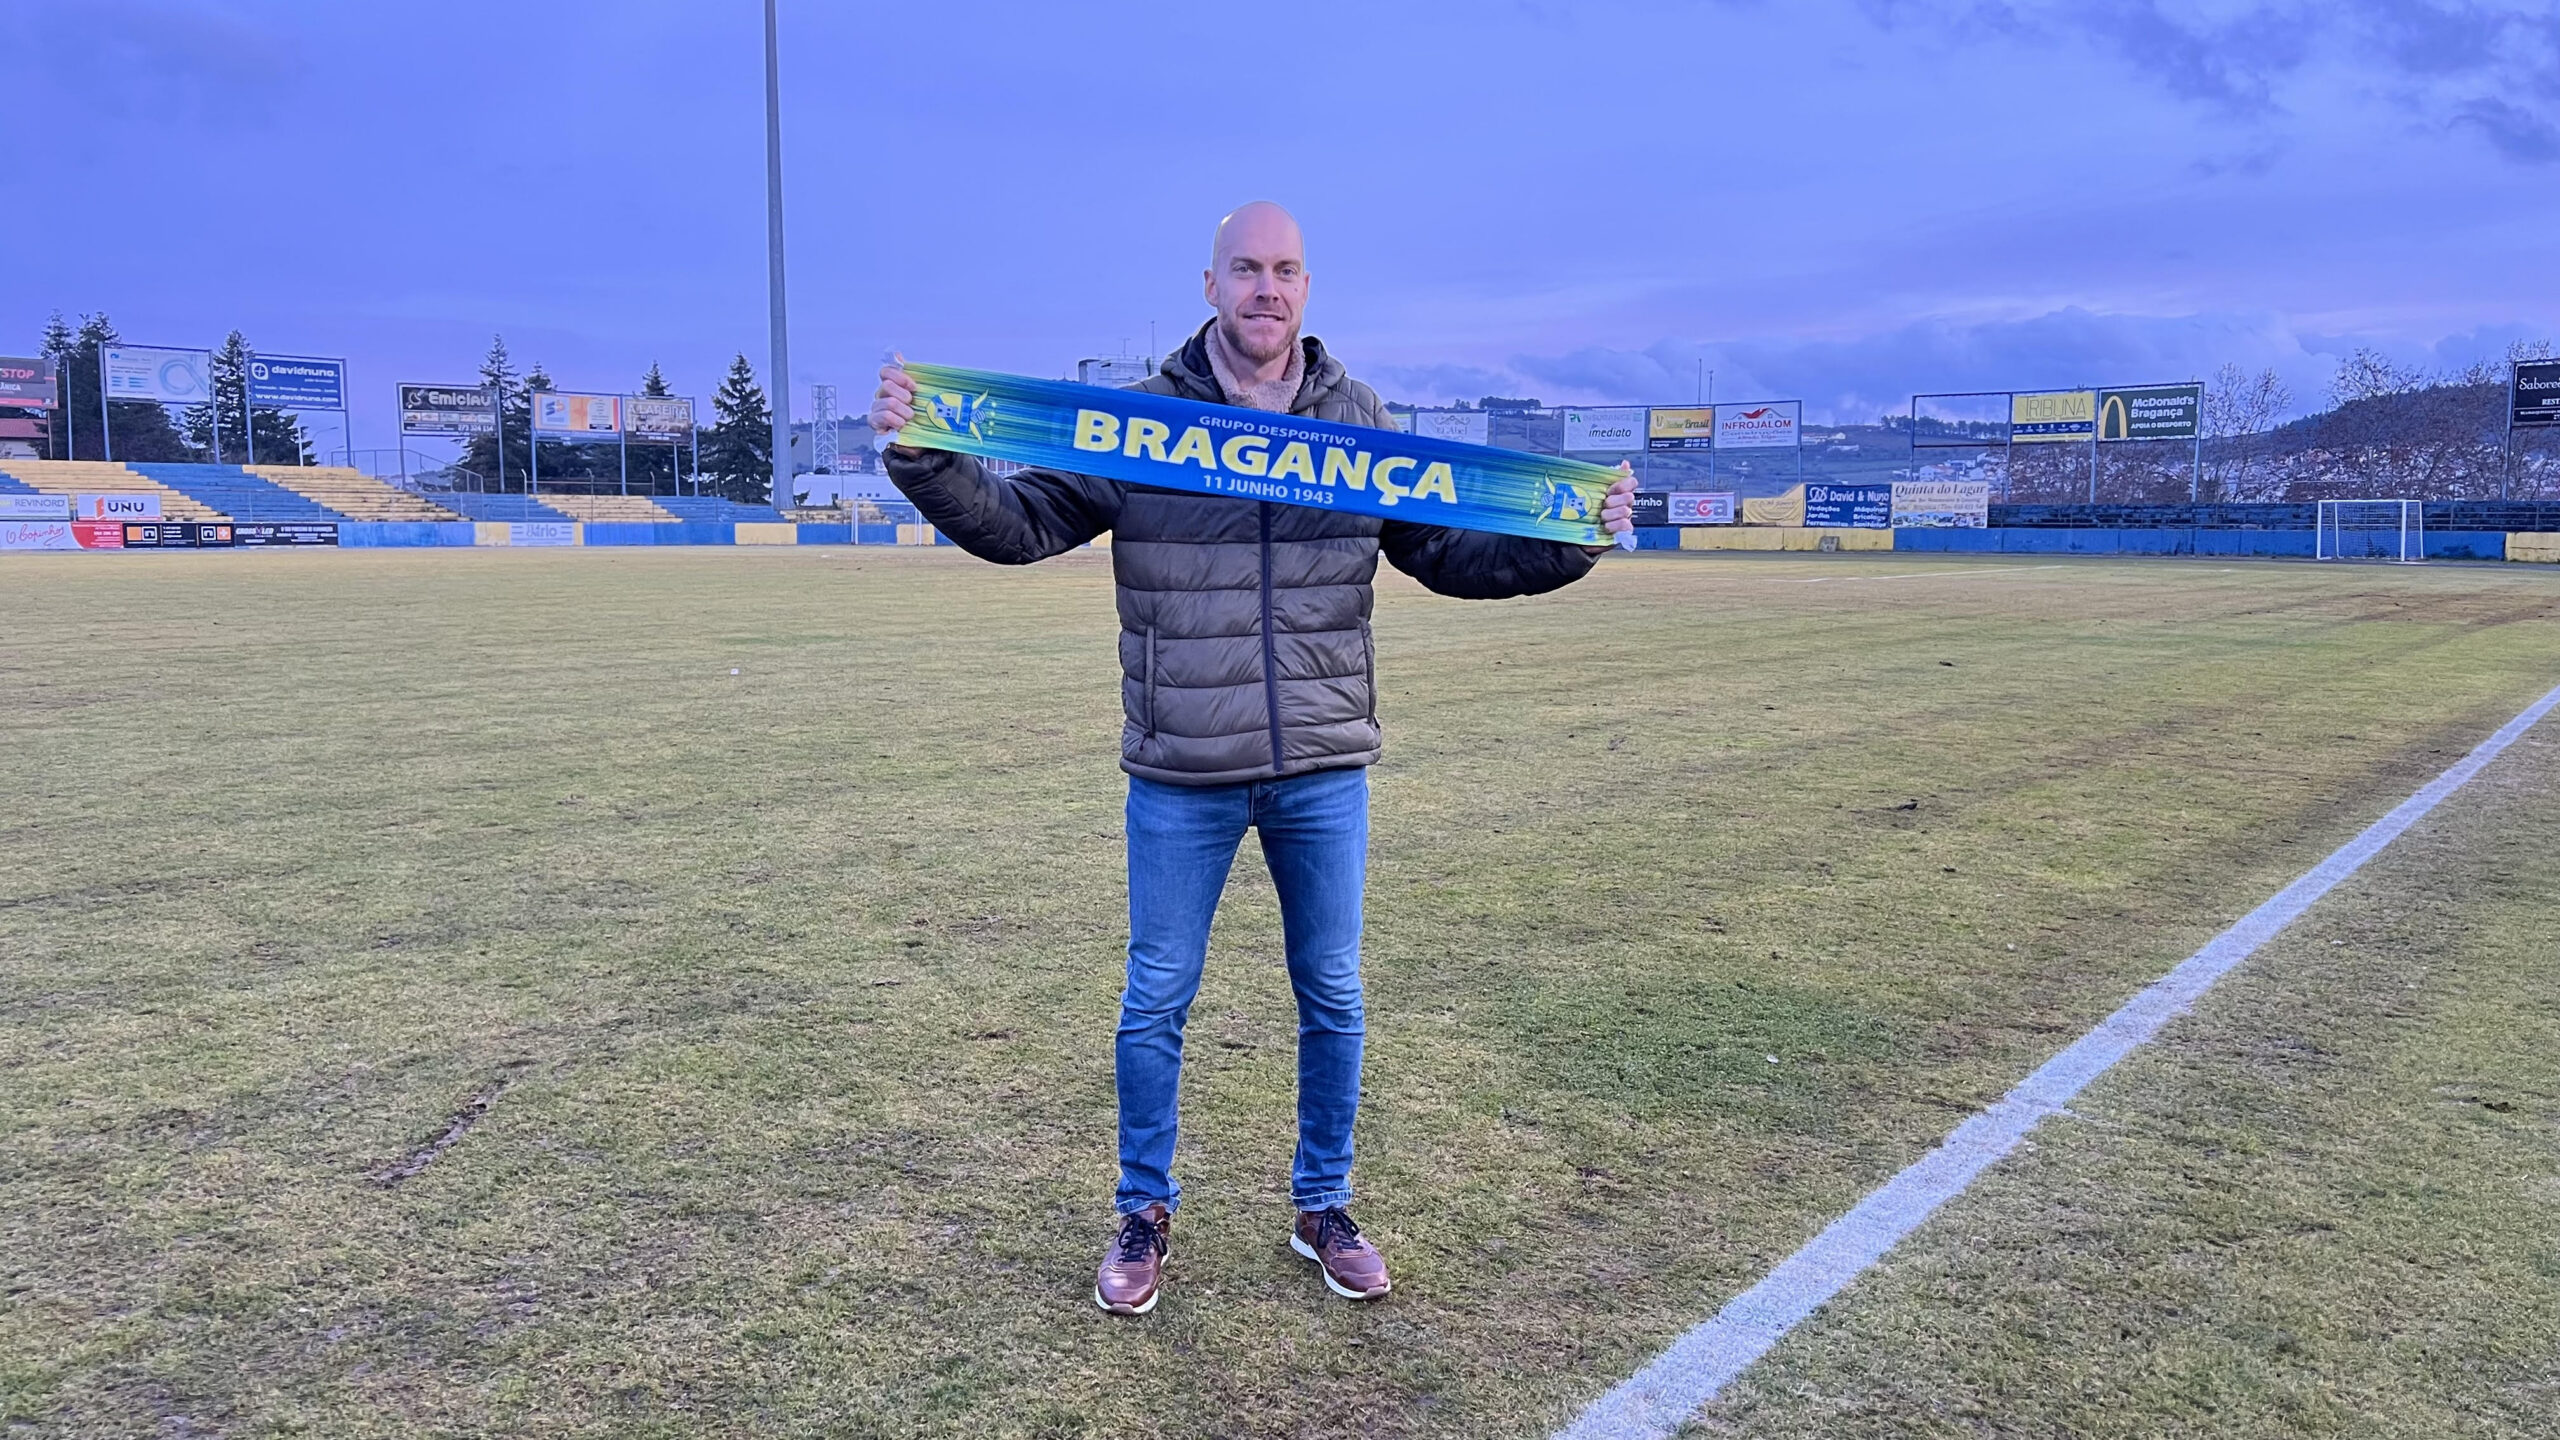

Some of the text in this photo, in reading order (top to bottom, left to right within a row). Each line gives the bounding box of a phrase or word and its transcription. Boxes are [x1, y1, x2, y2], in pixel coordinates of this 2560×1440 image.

[0, 367, 35, 379] STOP
[2131, 395, 2195, 407] McDonald's
[2130, 408, 2184, 419] Bragança
[1199, 415, 1357, 447] GRUPO DESPORTIVO
[1588, 427, 1632, 437] imediato
[1073, 409, 1458, 507] BRAGANÇA
[1203, 475, 1334, 505] 11 JUNHO 1943
[1829, 490, 1855, 502] David
[1857, 491, 1865, 501] &
[1895, 484, 1986, 498] Quinta do Lagar
[107, 502, 144, 513] UNU
